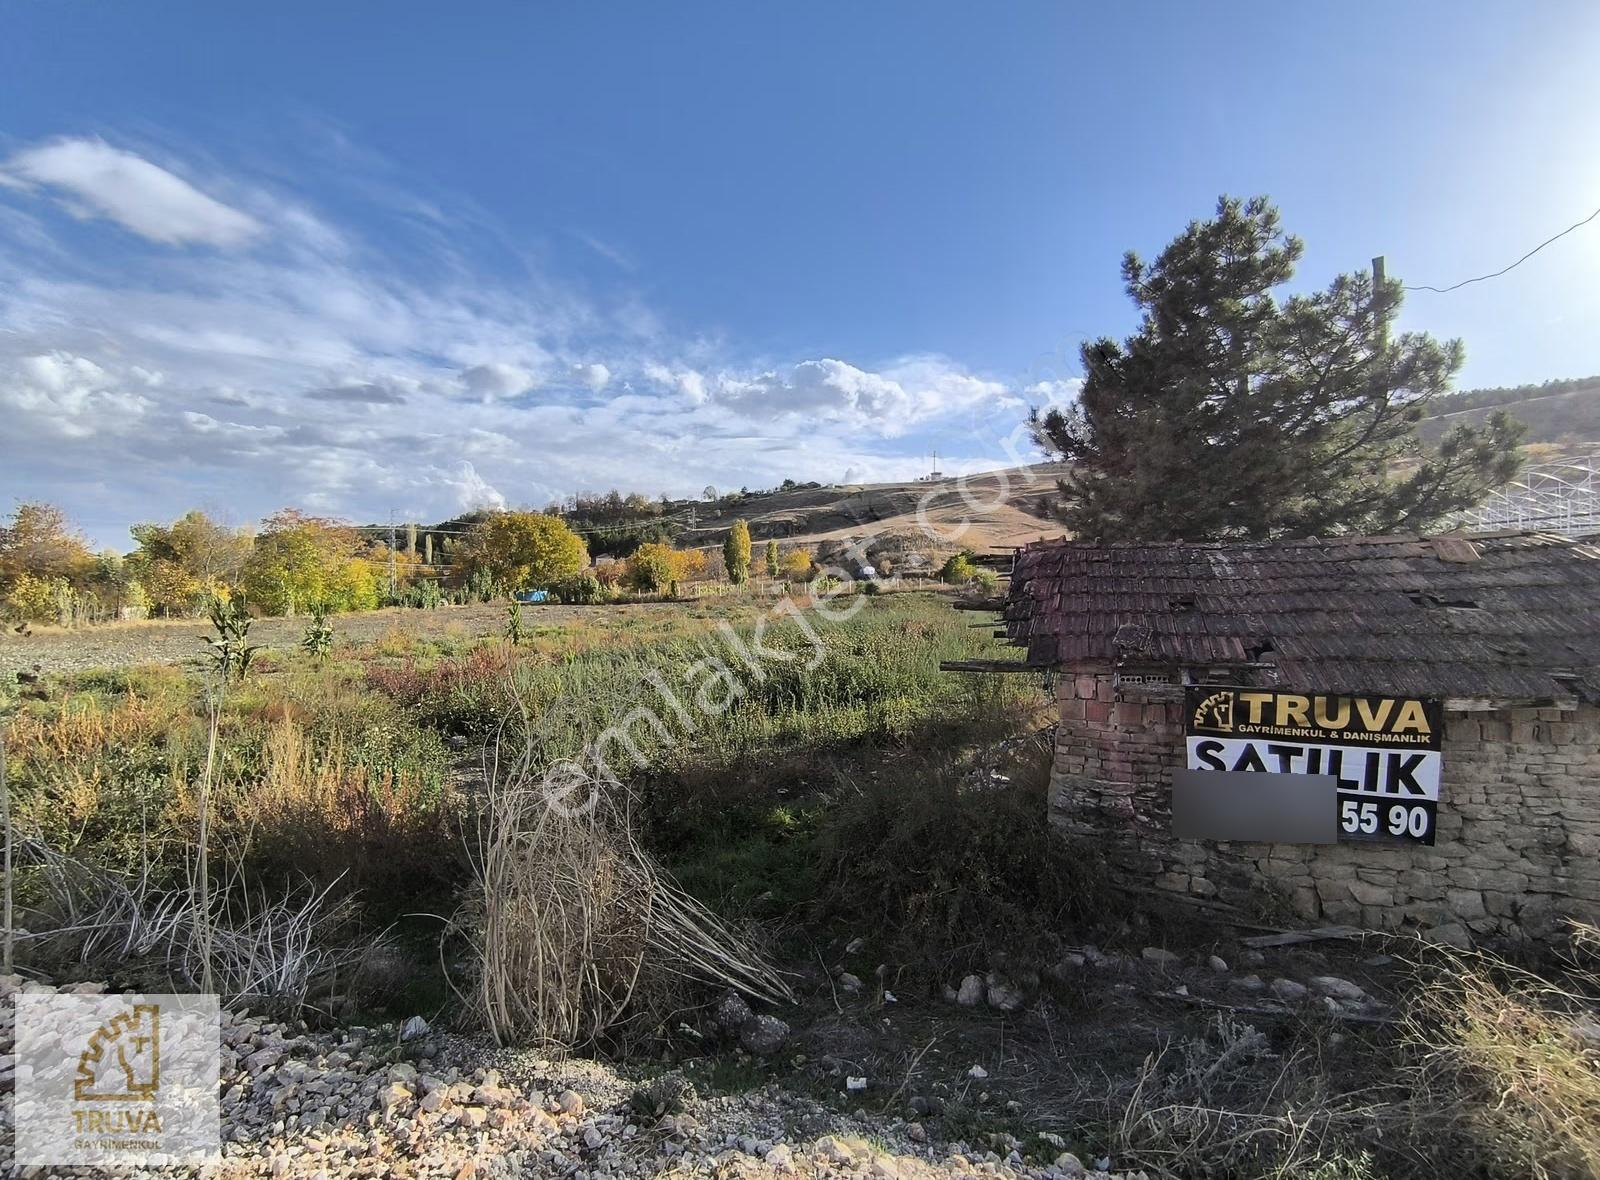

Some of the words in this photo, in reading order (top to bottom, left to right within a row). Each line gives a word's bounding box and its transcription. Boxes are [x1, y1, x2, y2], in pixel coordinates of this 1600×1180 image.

[1240, 693, 1431, 733] TRUVA
[1238, 724, 1326, 739] GAYRİMENKUL
[1330, 731, 1339, 740] &
[1343, 732, 1431, 744] DANIŞMANLIK
[1195, 740, 1426, 796] SATILIK
[1342, 801, 1378, 833] 55
[1388, 806, 1428, 838] 90
